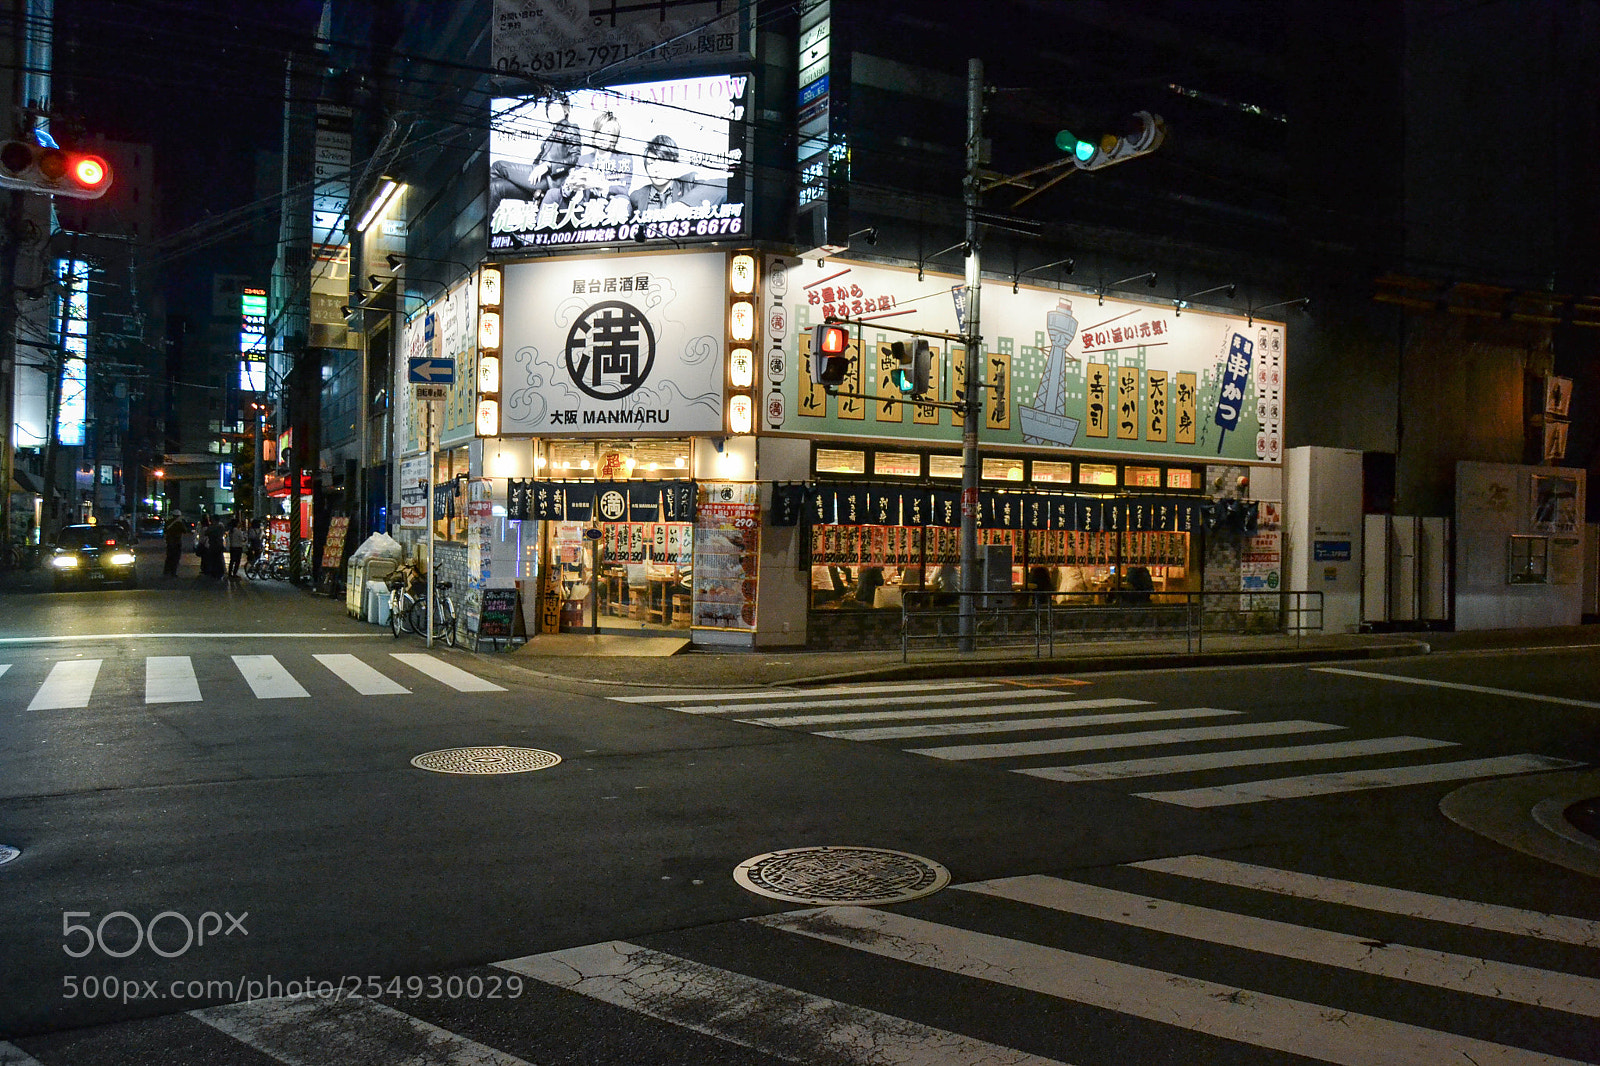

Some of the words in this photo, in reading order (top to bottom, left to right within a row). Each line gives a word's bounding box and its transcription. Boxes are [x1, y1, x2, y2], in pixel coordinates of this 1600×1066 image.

[497, 43, 630, 71] 06-6312-7971
[618, 217, 742, 240] 066363-6676
[572, 276, 649, 294] 屋台居酒屋
[808, 284, 863, 305] お昼から
[822, 295, 897, 320] 飲めるお店!
[1082, 319, 1168, 349] 安い!旨い!元気!
[570, 305, 649, 393] 満
[416, 387, 447, 398] 自転車を除く
[1090, 370, 1107, 430] 寿司
[1219, 352, 1249, 421] 串かつ
[1120, 371, 1136, 435] 串かつ
[1149, 376, 1165, 435] 天ぷら
[1177, 383, 1195, 435] 刺身
[550, 409, 578, 425] 大阪
[583, 409, 670, 424] MANMARU
[538, 488, 548, 517] 串かつ
[601, 491, 624, 518] 満
[656, 527, 664, 545] たこ
[669, 529, 678, 544] いか
[735, 518, 753, 528] 290
